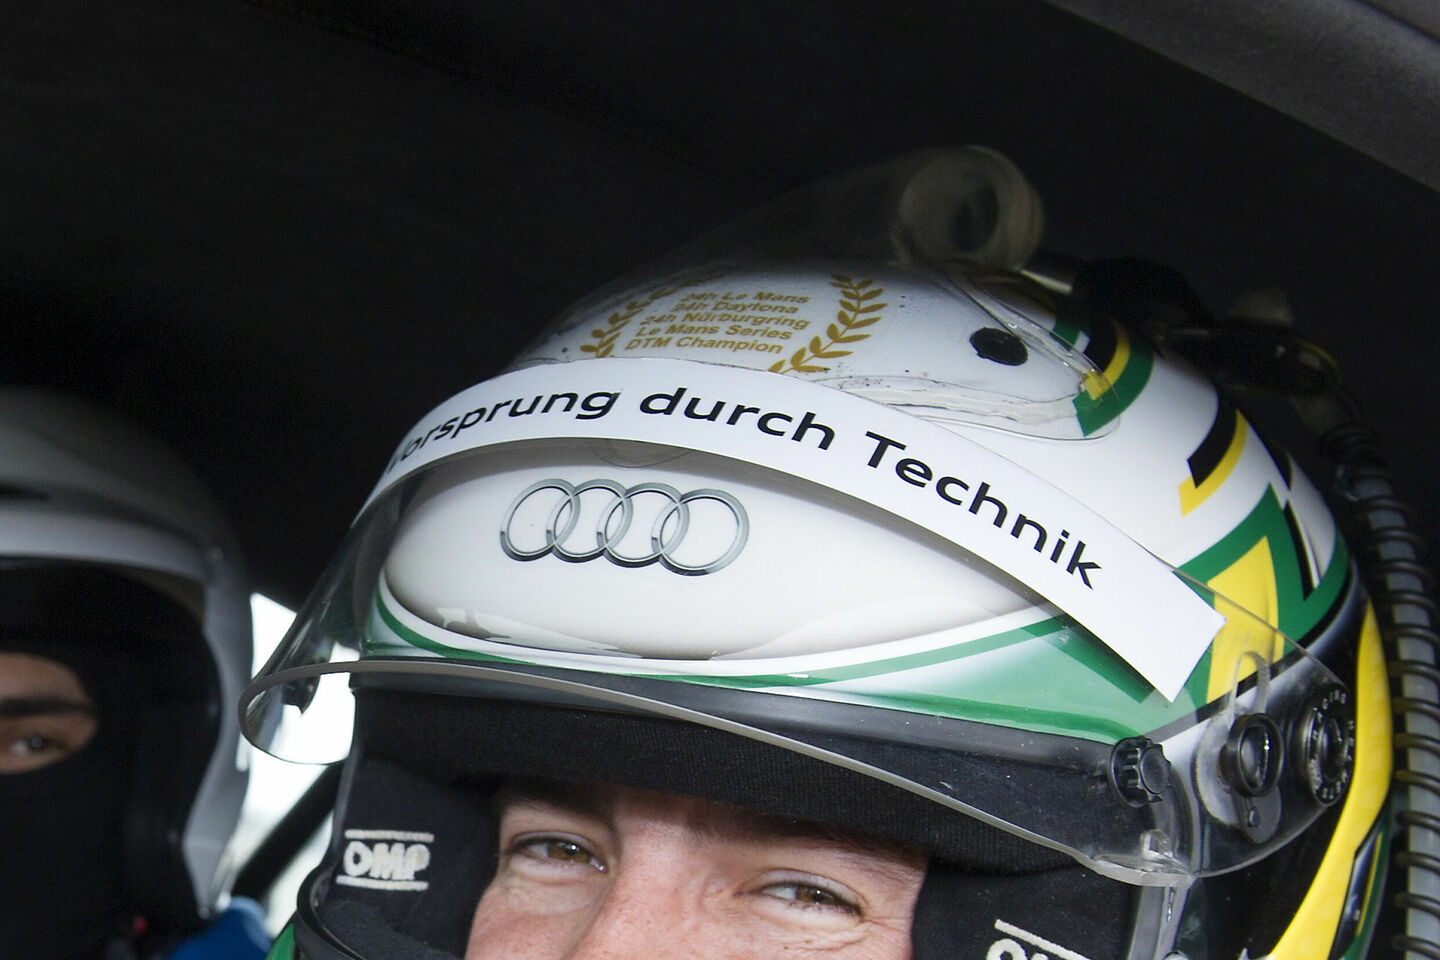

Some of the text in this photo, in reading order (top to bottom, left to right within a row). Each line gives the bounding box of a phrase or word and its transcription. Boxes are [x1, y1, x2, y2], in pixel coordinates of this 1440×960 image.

[753, 291, 810, 303] Mans
[712, 301, 799, 314] Daytona
[681, 311, 811, 330] Nürburgring
[635, 323, 794, 340] Le Mans Series
[624, 336, 784, 354] DTM Champion
[639, 387, 836, 451] durch
[864, 430, 1102, 590] Technik
[343, 840, 430, 880] OMP
